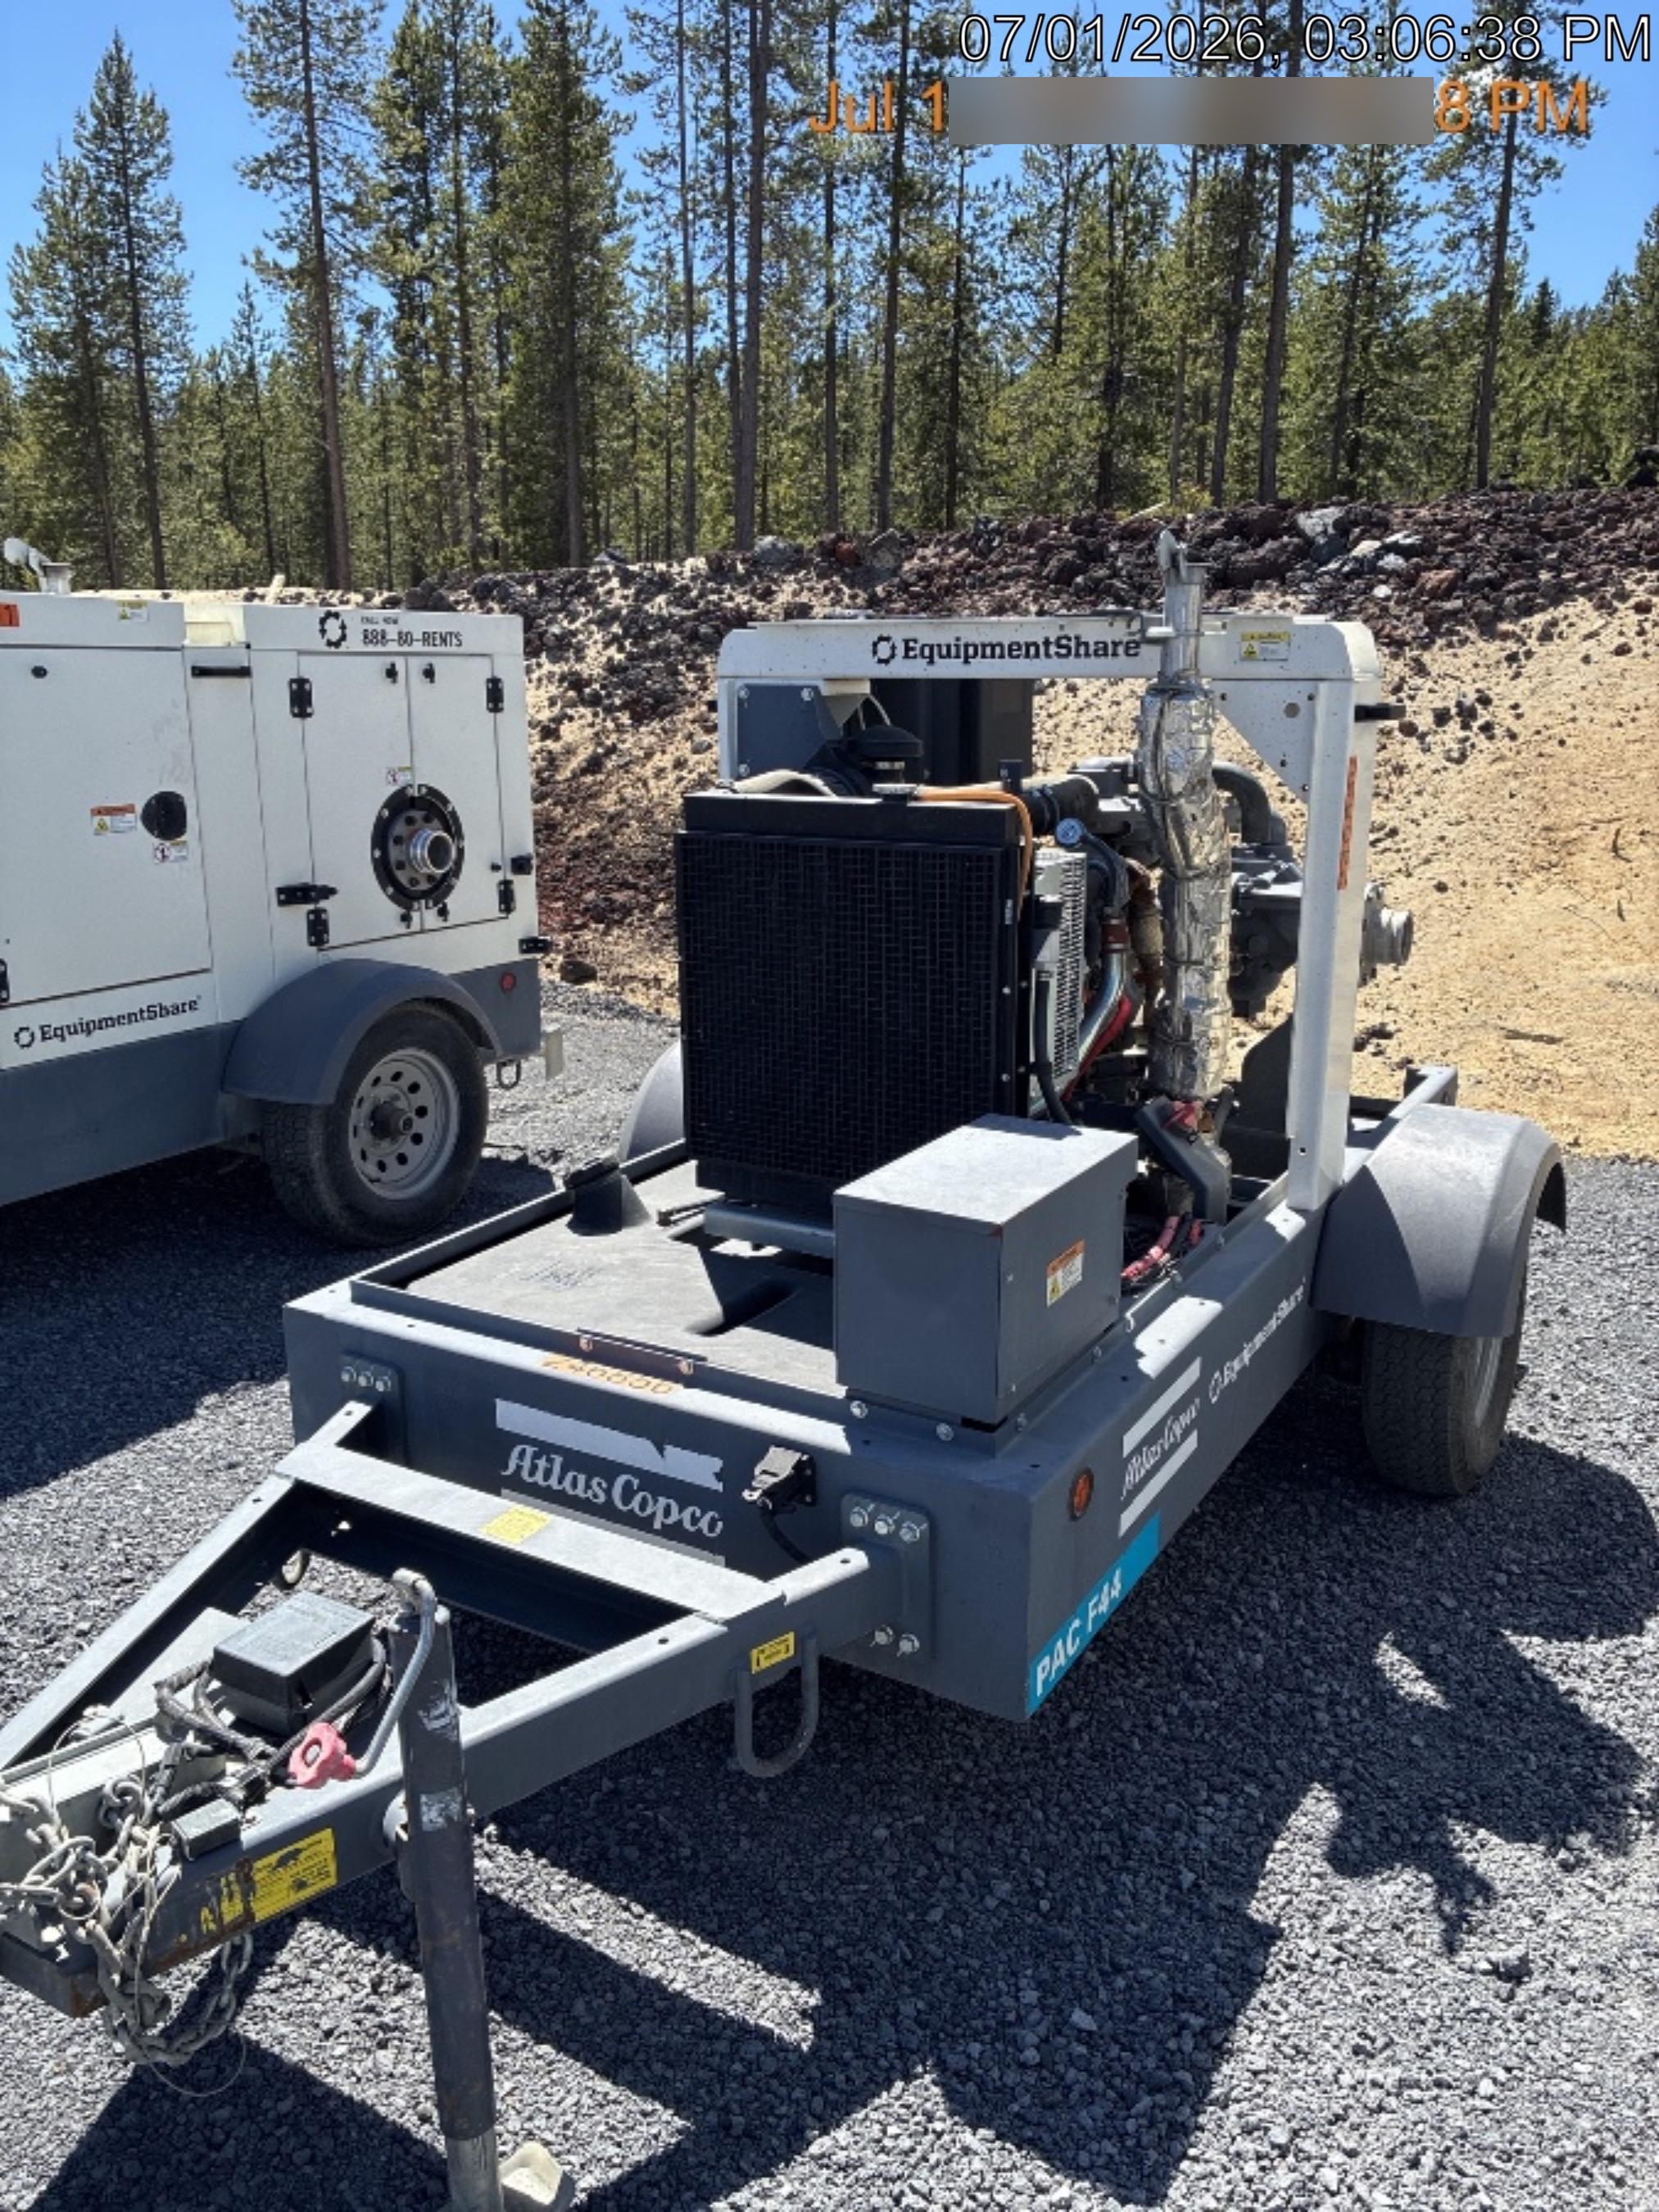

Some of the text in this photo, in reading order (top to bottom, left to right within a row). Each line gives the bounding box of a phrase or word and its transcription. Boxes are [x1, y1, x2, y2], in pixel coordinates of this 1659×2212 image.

[362, 628, 464, 648] 888-80-RENTS
[901, 634, 1142, 665] EquipmentShare
[39, 997, 200, 1043] EquipmentShare
[501, 1444, 609, 1505] Atlas
[610, 1474, 724, 1538] Copco
[1036, 1566, 1122, 1698] PAC F44
